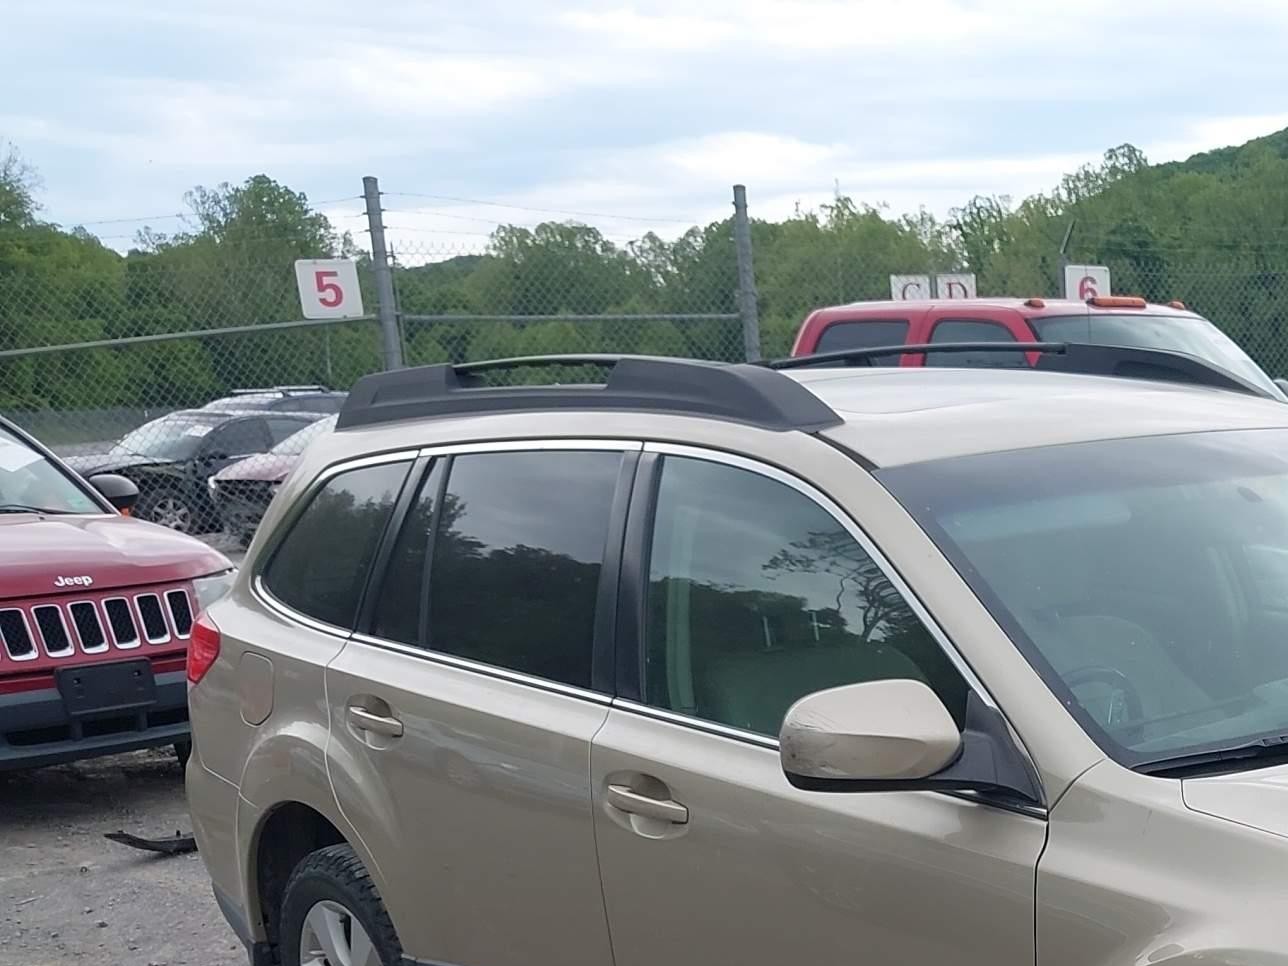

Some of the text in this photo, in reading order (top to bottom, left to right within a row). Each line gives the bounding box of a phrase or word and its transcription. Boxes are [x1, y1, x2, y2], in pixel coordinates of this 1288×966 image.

[315, 271, 343, 308] 5
[1079, 276, 1098, 301] 6
[54, 575, 93, 587] Jeep
